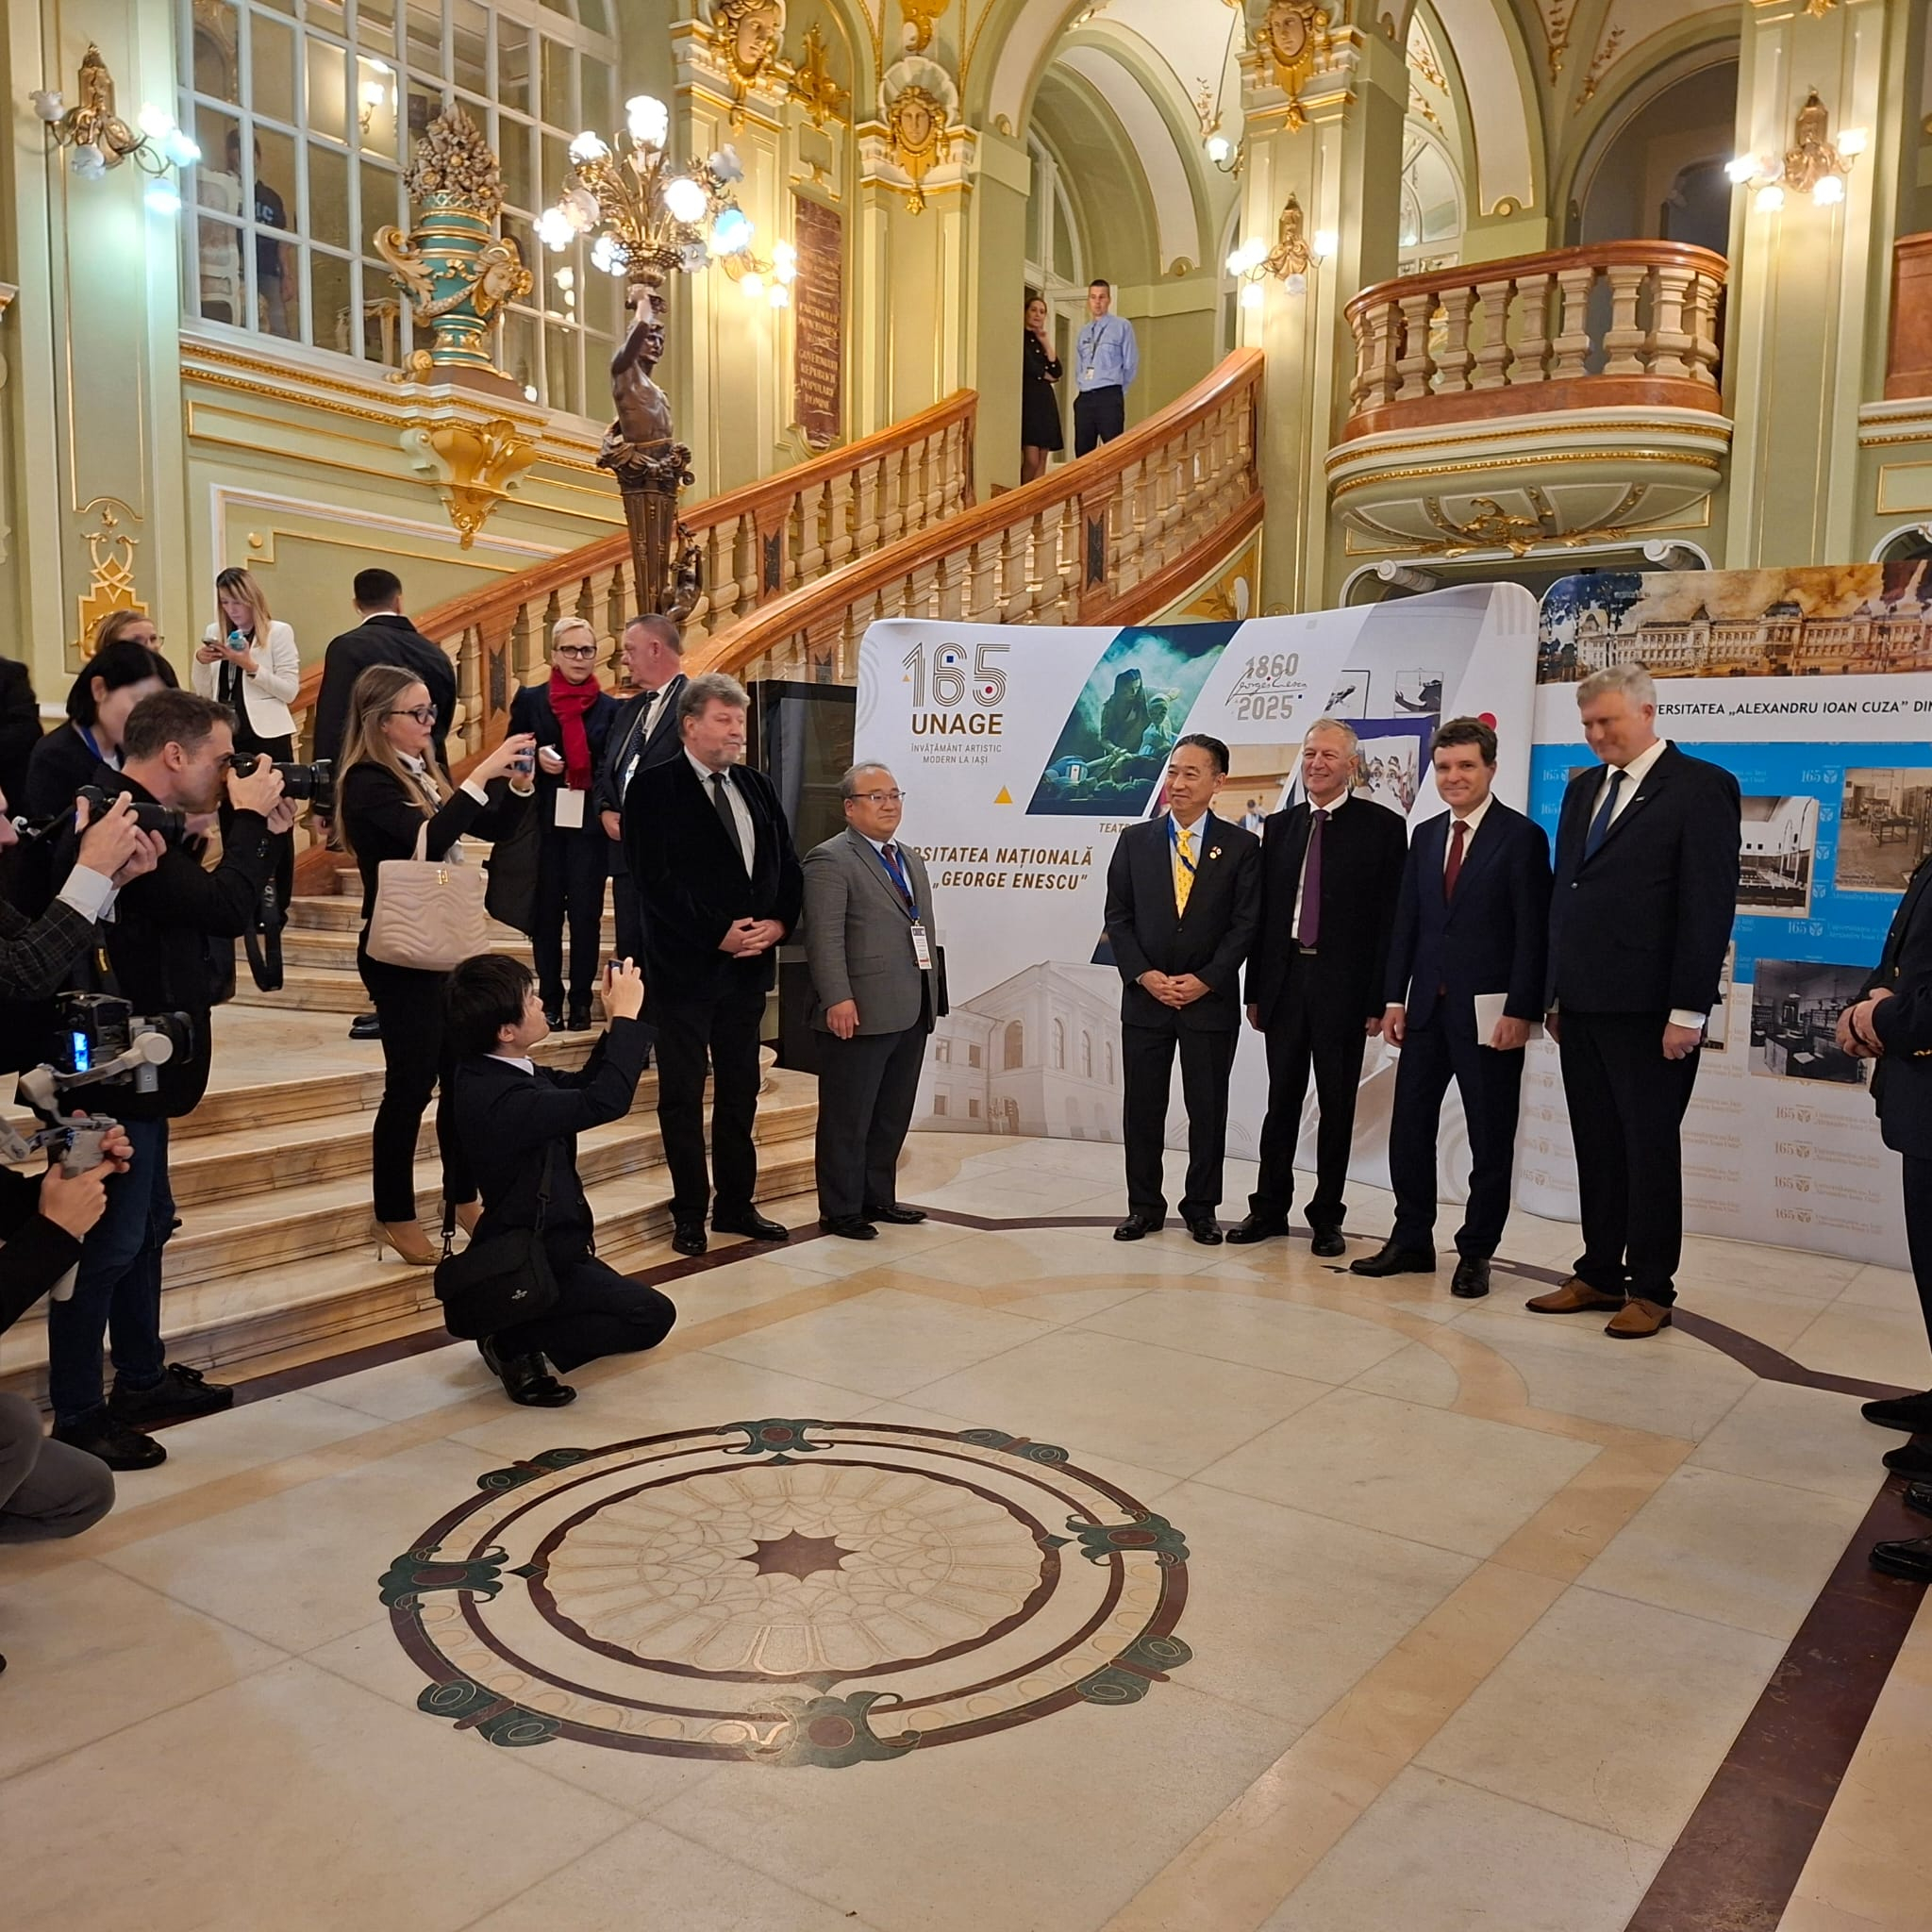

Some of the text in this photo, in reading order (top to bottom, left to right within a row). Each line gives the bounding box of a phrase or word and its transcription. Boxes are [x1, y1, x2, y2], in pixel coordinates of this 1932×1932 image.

[1245, 653, 1299, 678] 1860
[902, 641, 1011, 708] 165
[1238, 694, 1294, 721] 2025
[1823, 702, 1857, 713] IOAN
[911, 713, 1003, 735] UNAGE
[965, 744, 1002, 753] ARTISTIC
[1802, 770, 1821, 783] 165
[996, 846, 1092, 868] NAȚIONALĂ
[1788, 922, 1807, 934] 165
[1775, 1106, 1795, 1120] 165
[1775, 1141, 1794, 1155] 165
[1774, 1175, 1793, 1190] 165
[1775, 1208, 1795, 1221] 165
